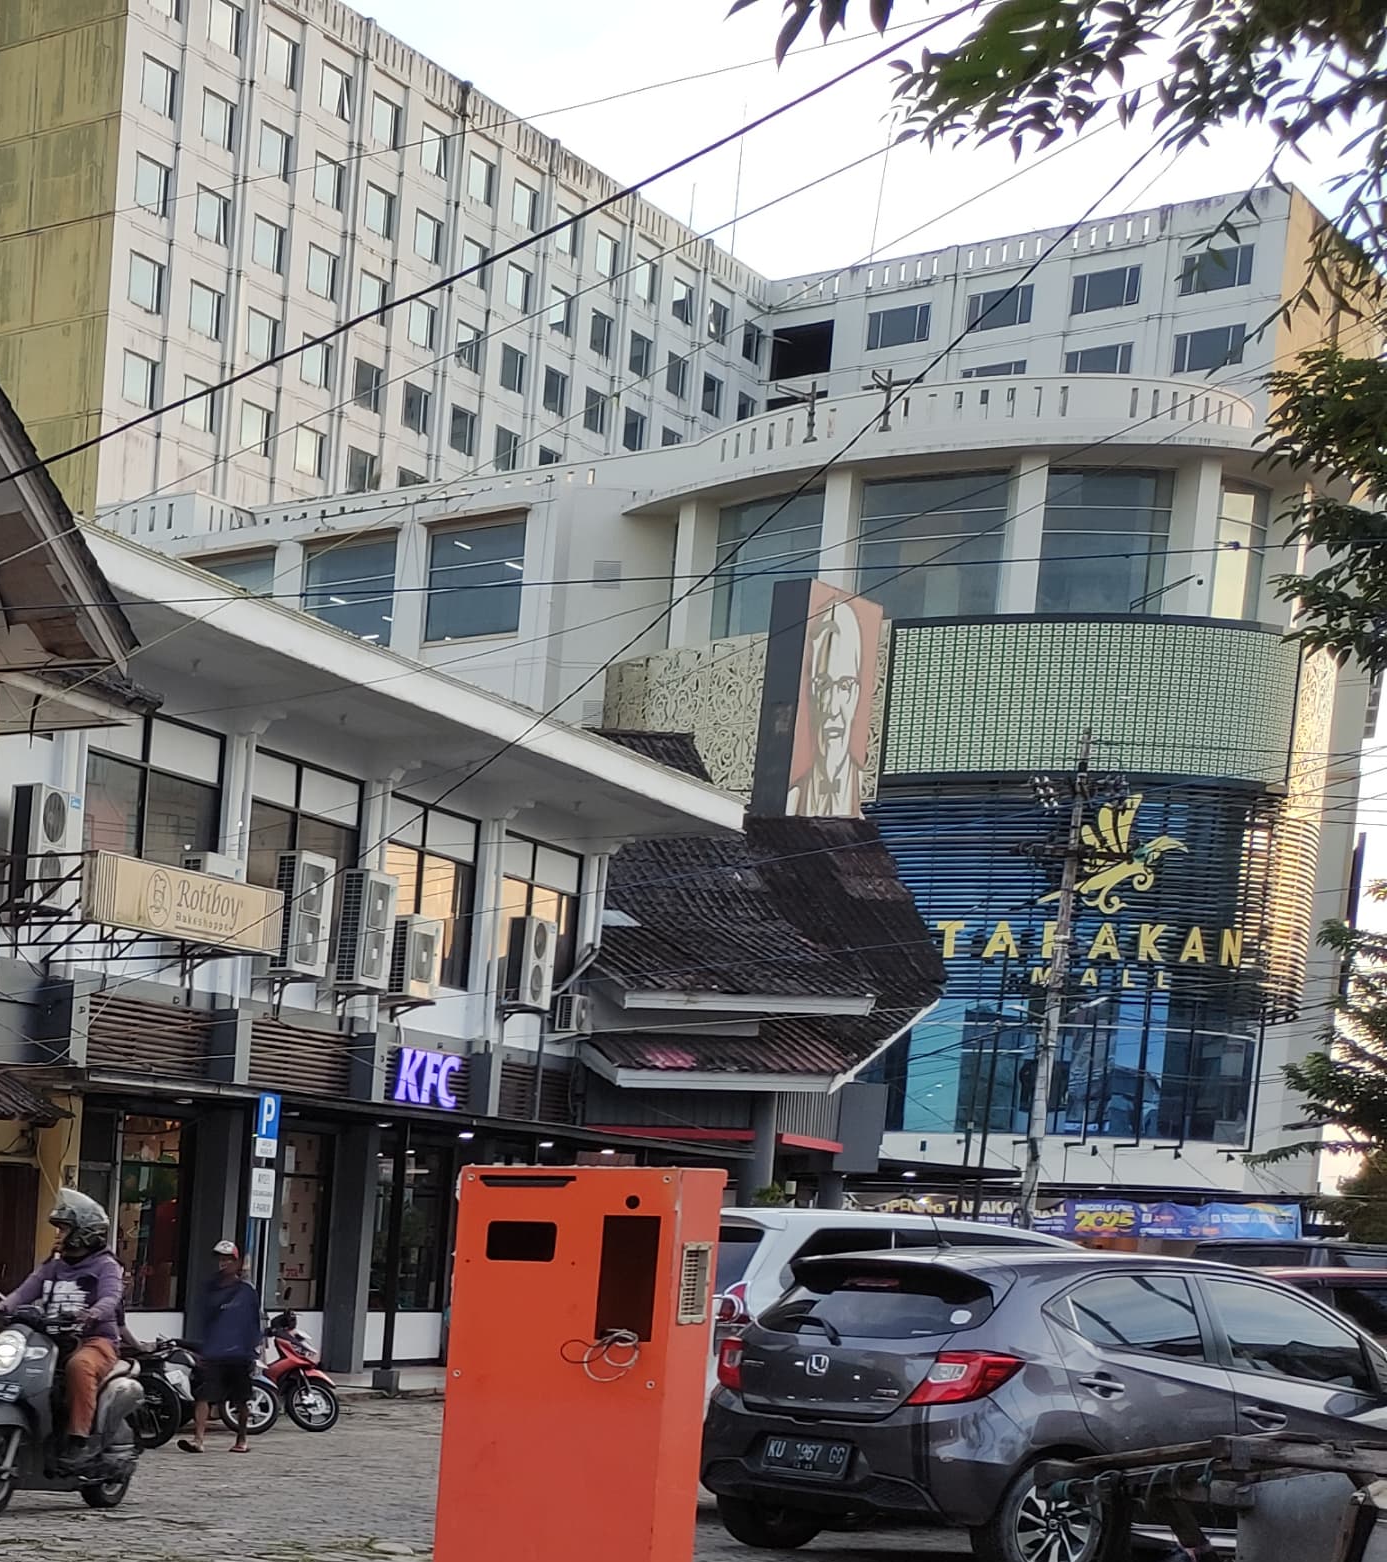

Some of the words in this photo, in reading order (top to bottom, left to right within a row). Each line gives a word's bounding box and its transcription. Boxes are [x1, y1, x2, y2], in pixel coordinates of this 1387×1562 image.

[177, 879, 240, 930] Rotiboy
[1029, 966, 1172, 989] MALL
[394, 1047, 462, 1108] KFC
[262, 1096, 276, 1135] P
[1075, 1210, 1135, 1233] 2025
